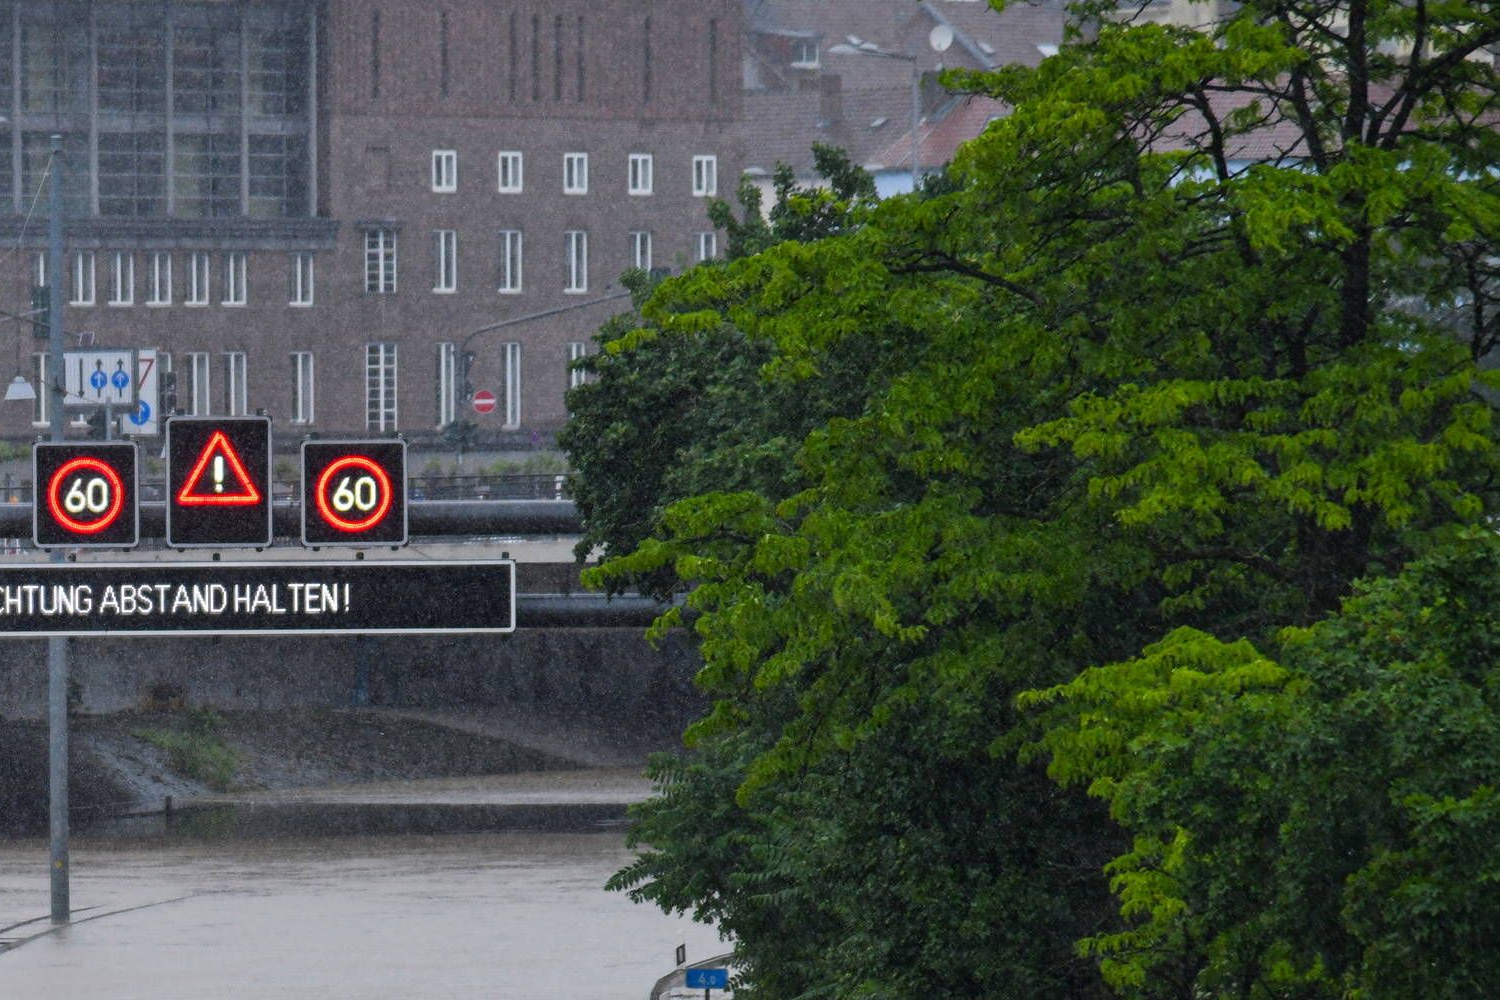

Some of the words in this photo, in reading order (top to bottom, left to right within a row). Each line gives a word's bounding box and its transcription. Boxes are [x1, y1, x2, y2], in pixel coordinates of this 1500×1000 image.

[65, 477, 108, 513] 60
[332, 476, 376, 512] 60
[100, 584, 227, 615] ABSTAND
